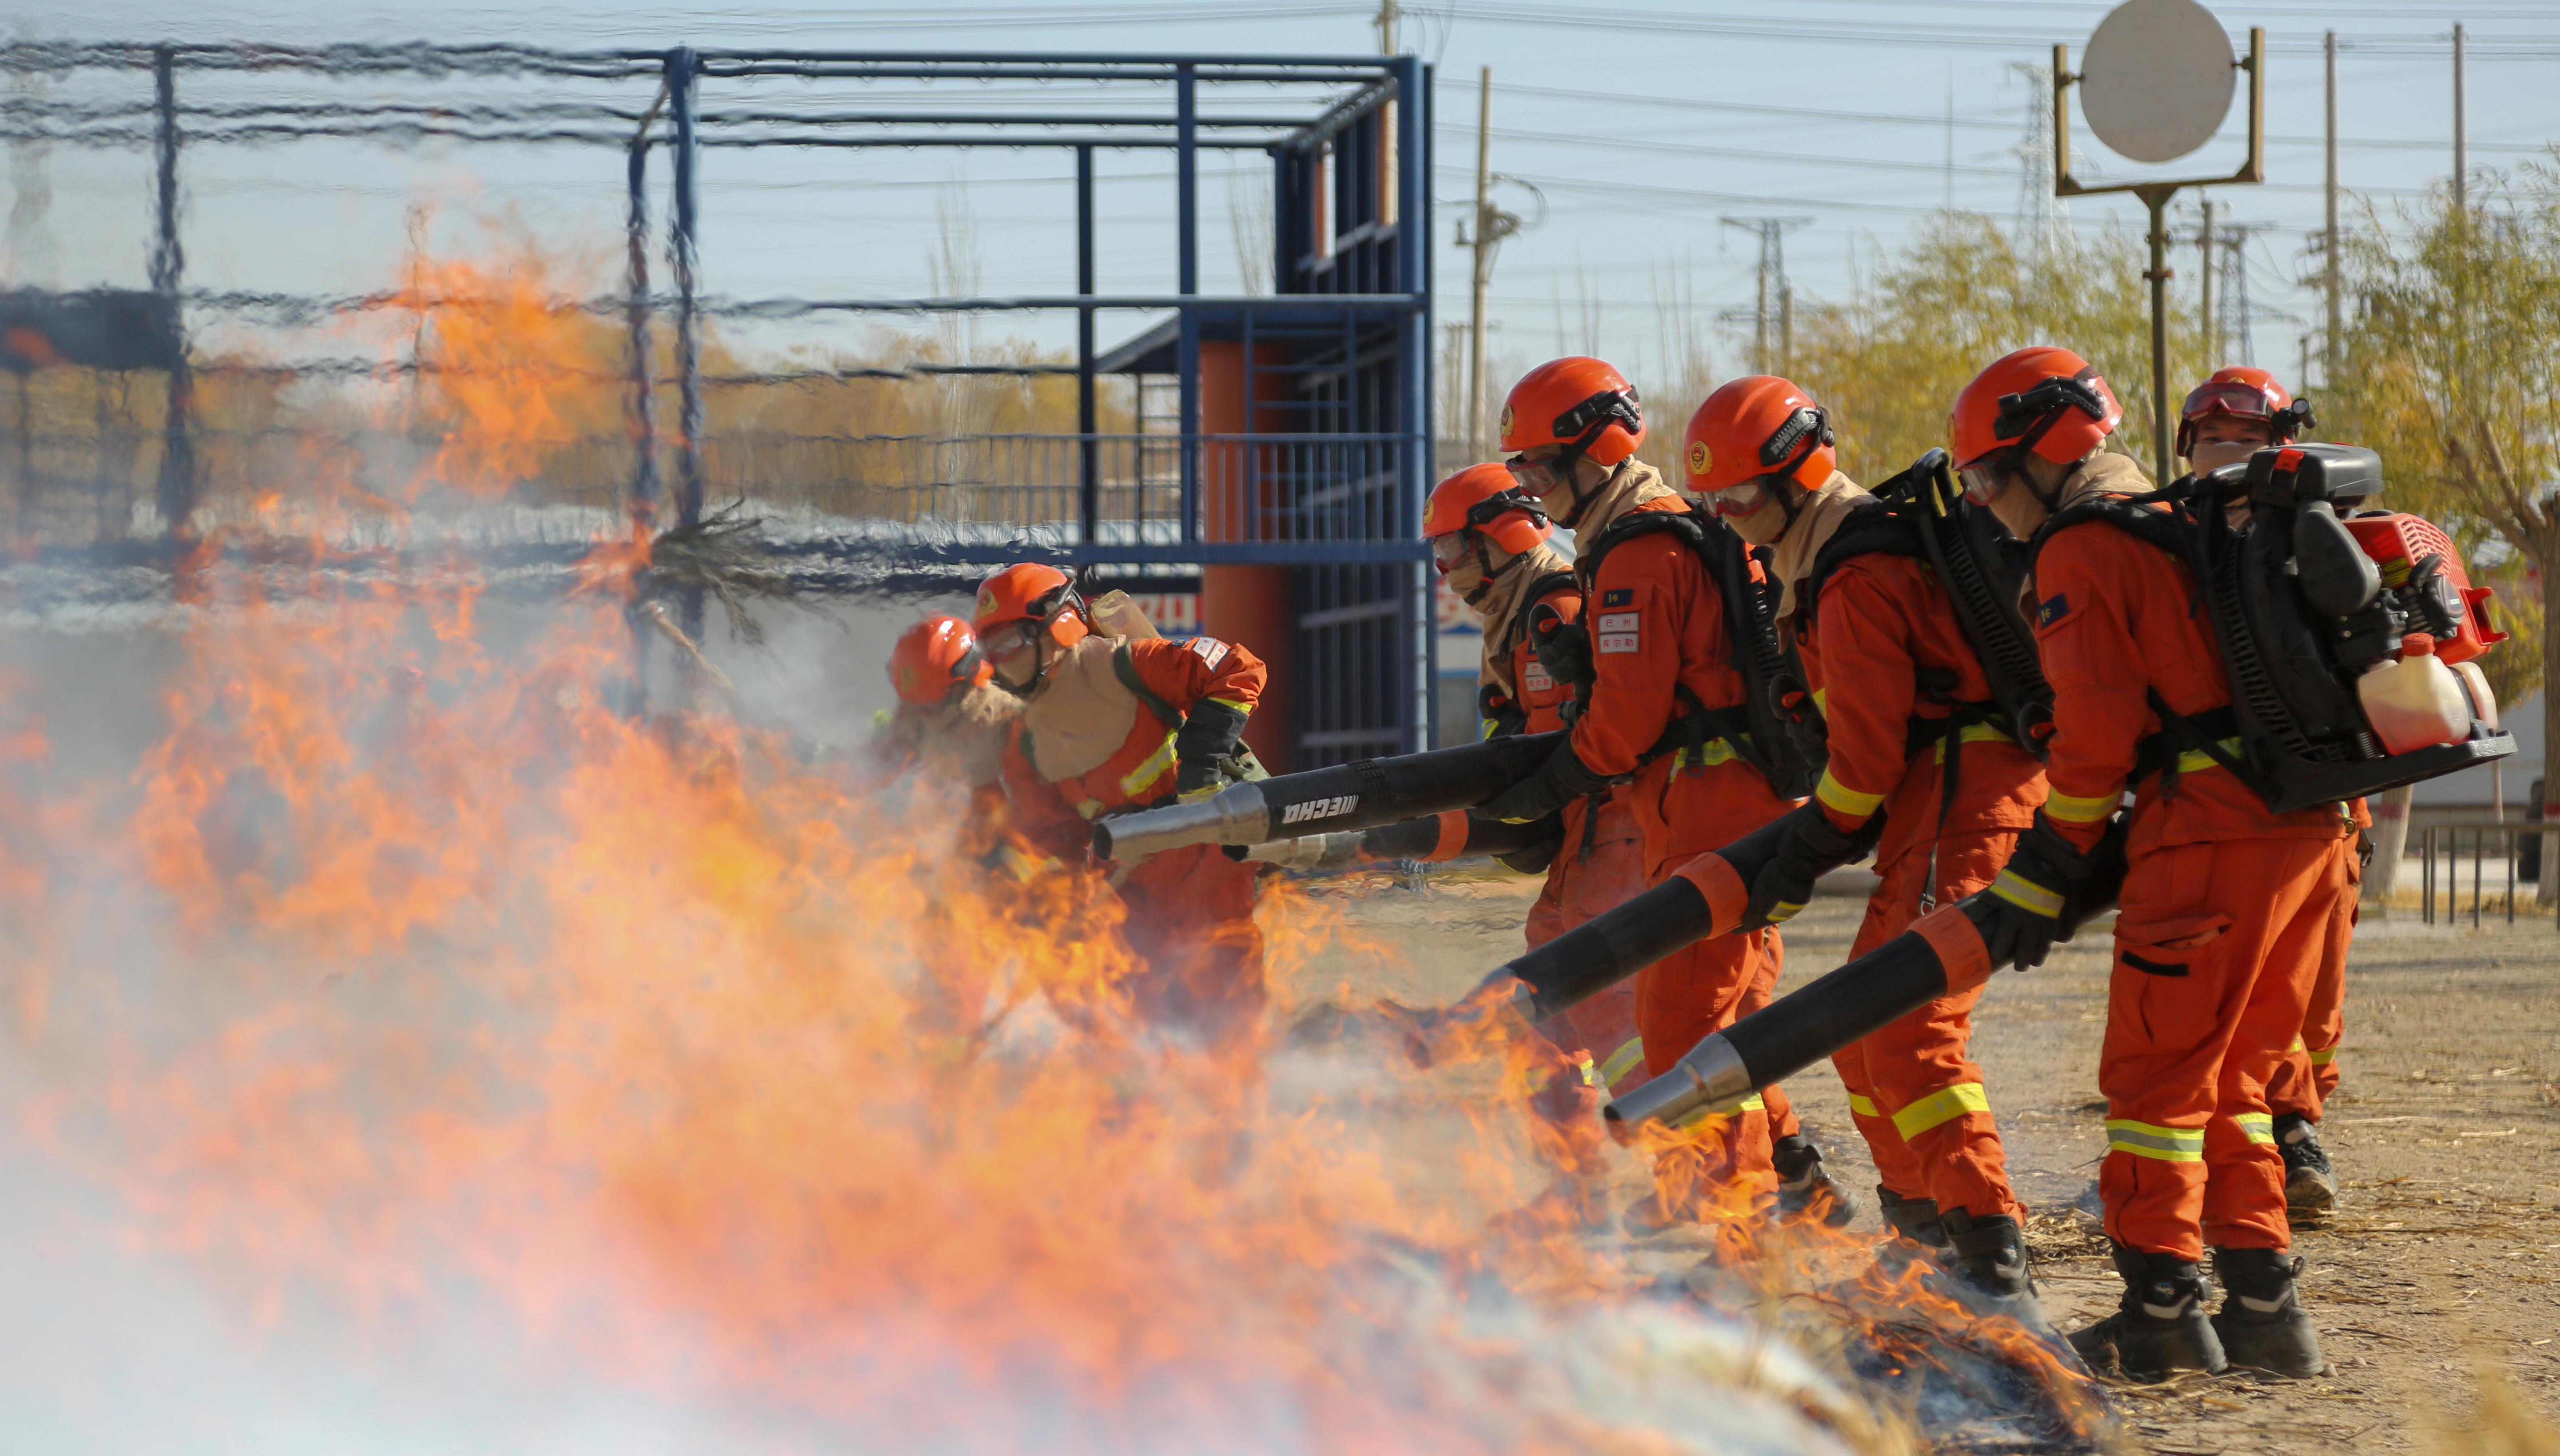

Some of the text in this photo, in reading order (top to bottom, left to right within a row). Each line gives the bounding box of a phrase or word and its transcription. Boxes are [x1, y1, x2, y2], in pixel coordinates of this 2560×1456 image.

[1606, 618, 1631, 627] 巴州
[1604, 638, 1634, 648] 库尔勒
[1283, 796, 1343, 824] ECHO
